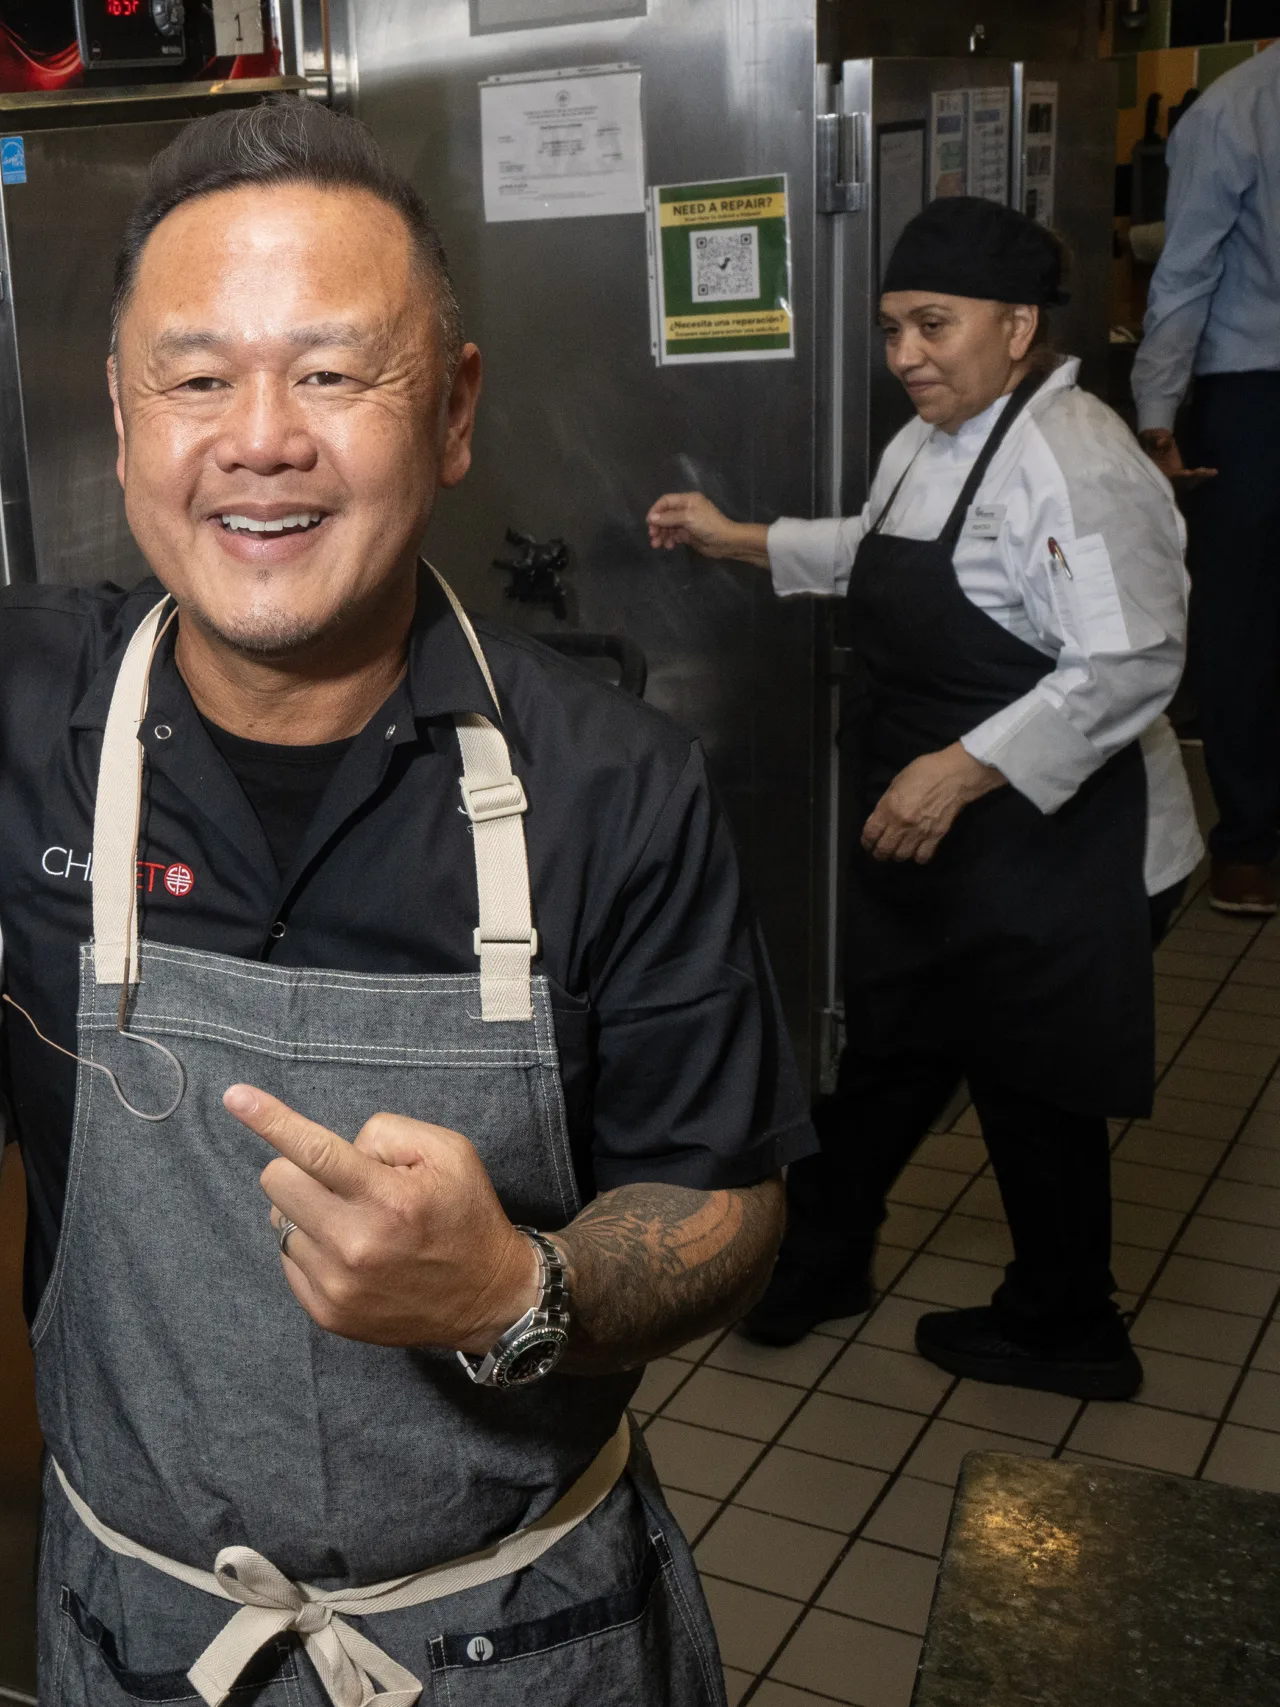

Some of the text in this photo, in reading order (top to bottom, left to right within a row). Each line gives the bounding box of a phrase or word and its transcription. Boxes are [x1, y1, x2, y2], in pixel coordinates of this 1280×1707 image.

[234, 13, 244, 42] 1
[673, 197, 773, 216] NEED A REPAIR?
[669, 320, 712, 332] ¿Necesita
[714, 318, 730, 327] una
